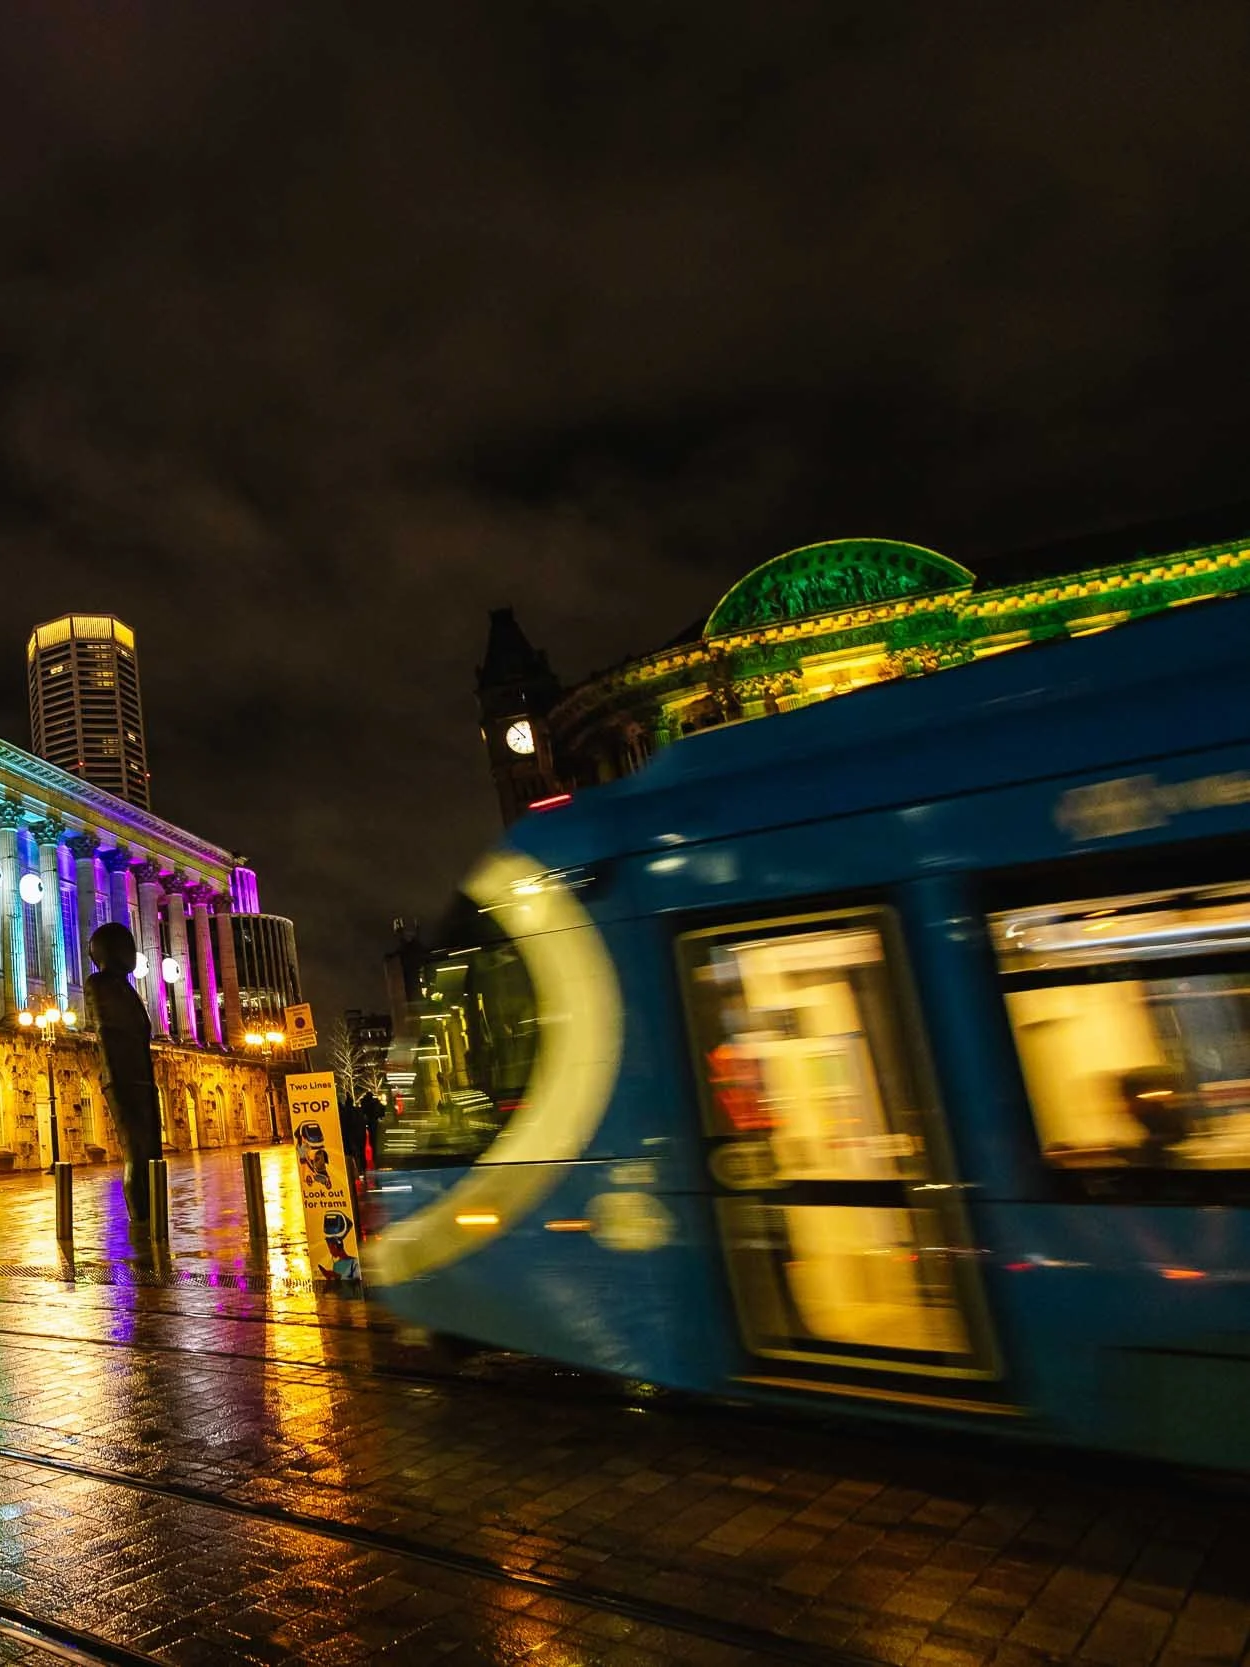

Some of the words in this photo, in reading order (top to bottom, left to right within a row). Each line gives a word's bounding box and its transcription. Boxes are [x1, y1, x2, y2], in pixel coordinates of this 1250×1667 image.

[292, 1100, 330, 1114] STOP
[303, 1190, 326, 1198] Look
[328, 1190, 344, 1198] out
[304, 1200, 317, 1209] for
[320, 1200, 347, 1208] trams
